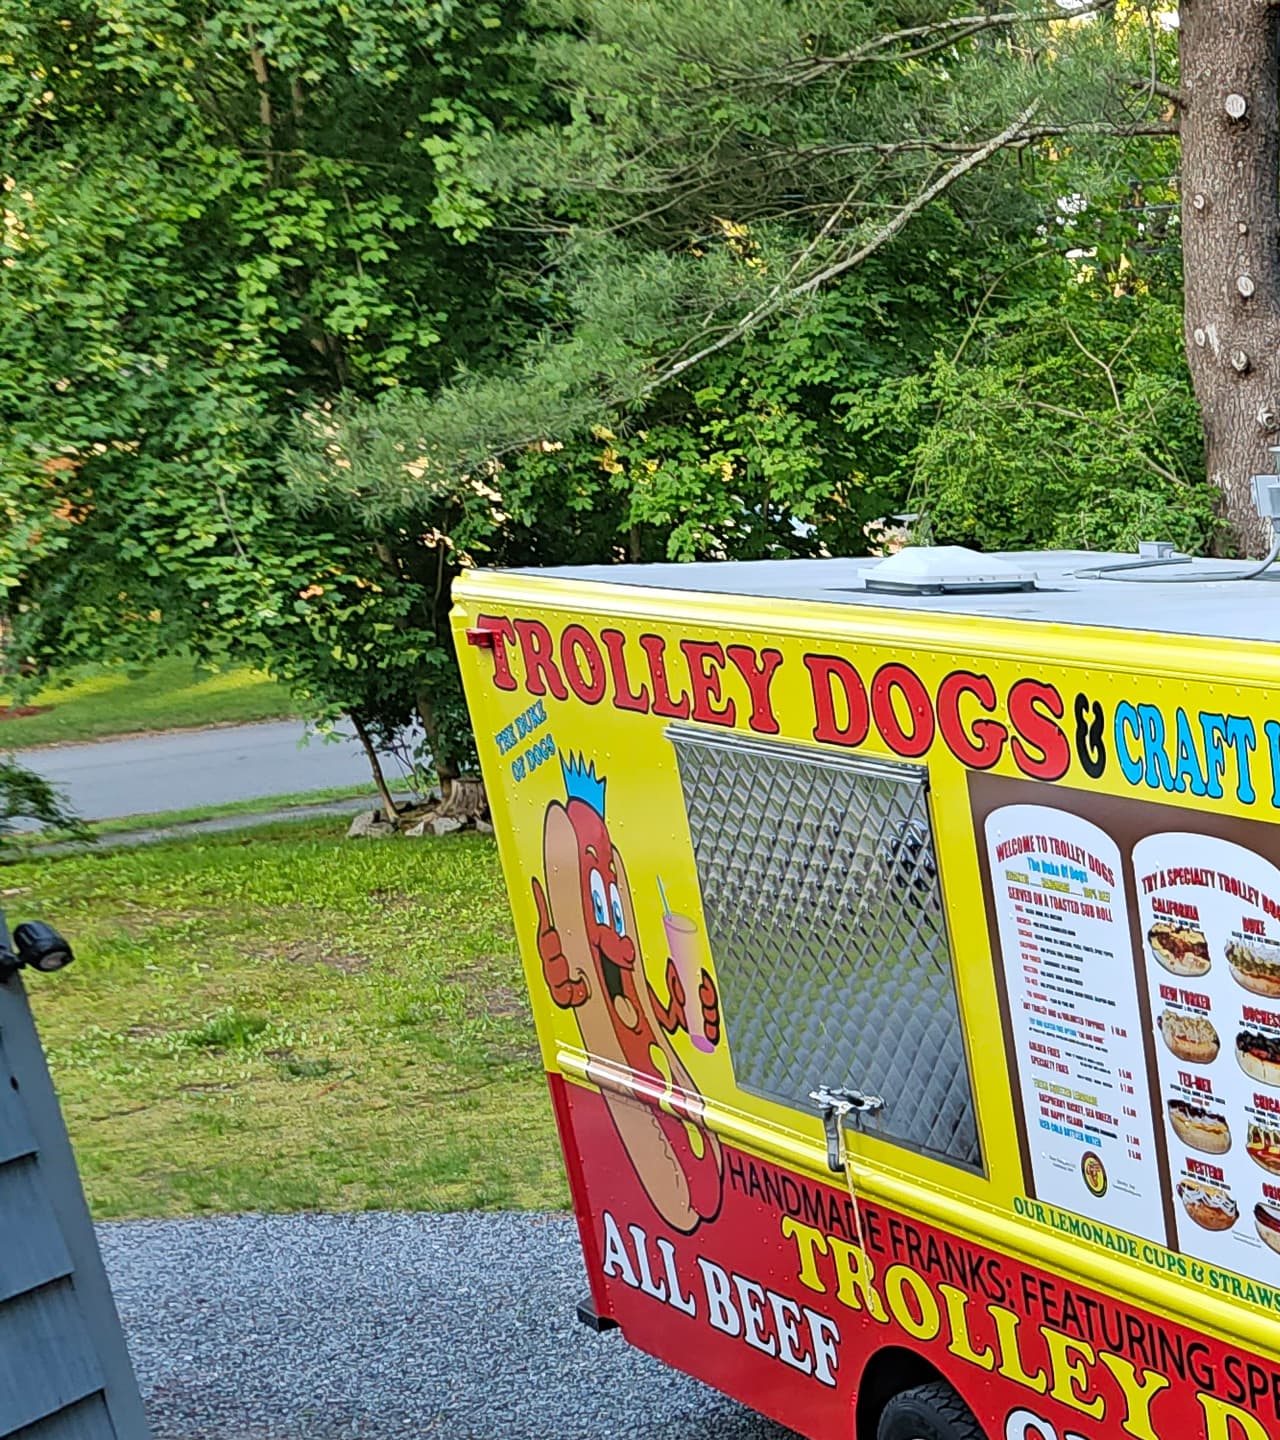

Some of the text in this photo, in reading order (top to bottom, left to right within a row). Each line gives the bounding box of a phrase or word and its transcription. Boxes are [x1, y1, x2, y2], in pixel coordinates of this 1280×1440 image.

[477, 614, 783, 735] TROLLEY
[802, 652, 1072, 783] DOGS
[1075, 692, 1106, 780] &
[1114, 700, 1257, 805] CRAFT
[996, 835, 1036, 862] WELCOME
[1036, 835, 1048, 853] TO
[1048, 836, 1086, 866] TROLLEY
[1087, 852, 1115, 887] DOGS
[1142, 872, 1159, 895] TRY
[1160, 871, 1166, 888] A
[1167, 867, 1216, 888] SPECIALTY
[1217, 872, 1260, 907] TROLLEY
[1050, 895, 1079, 915] TOASTED
[727, 1149, 886, 1255] HANDMADE
[890, 1218, 1015, 1304] FRANKS:
[1022, 1272, 1216, 1393] FEATURING
[1013, 1196, 1045, 1224] OUR
[1050, 1207, 1140, 1260] LEMONADE
[1142, 1245, 1187, 1279] CUPS
[1191, 1264, 1204, 1283] &
[602, 1210, 841, 1387] ALL BEEF
